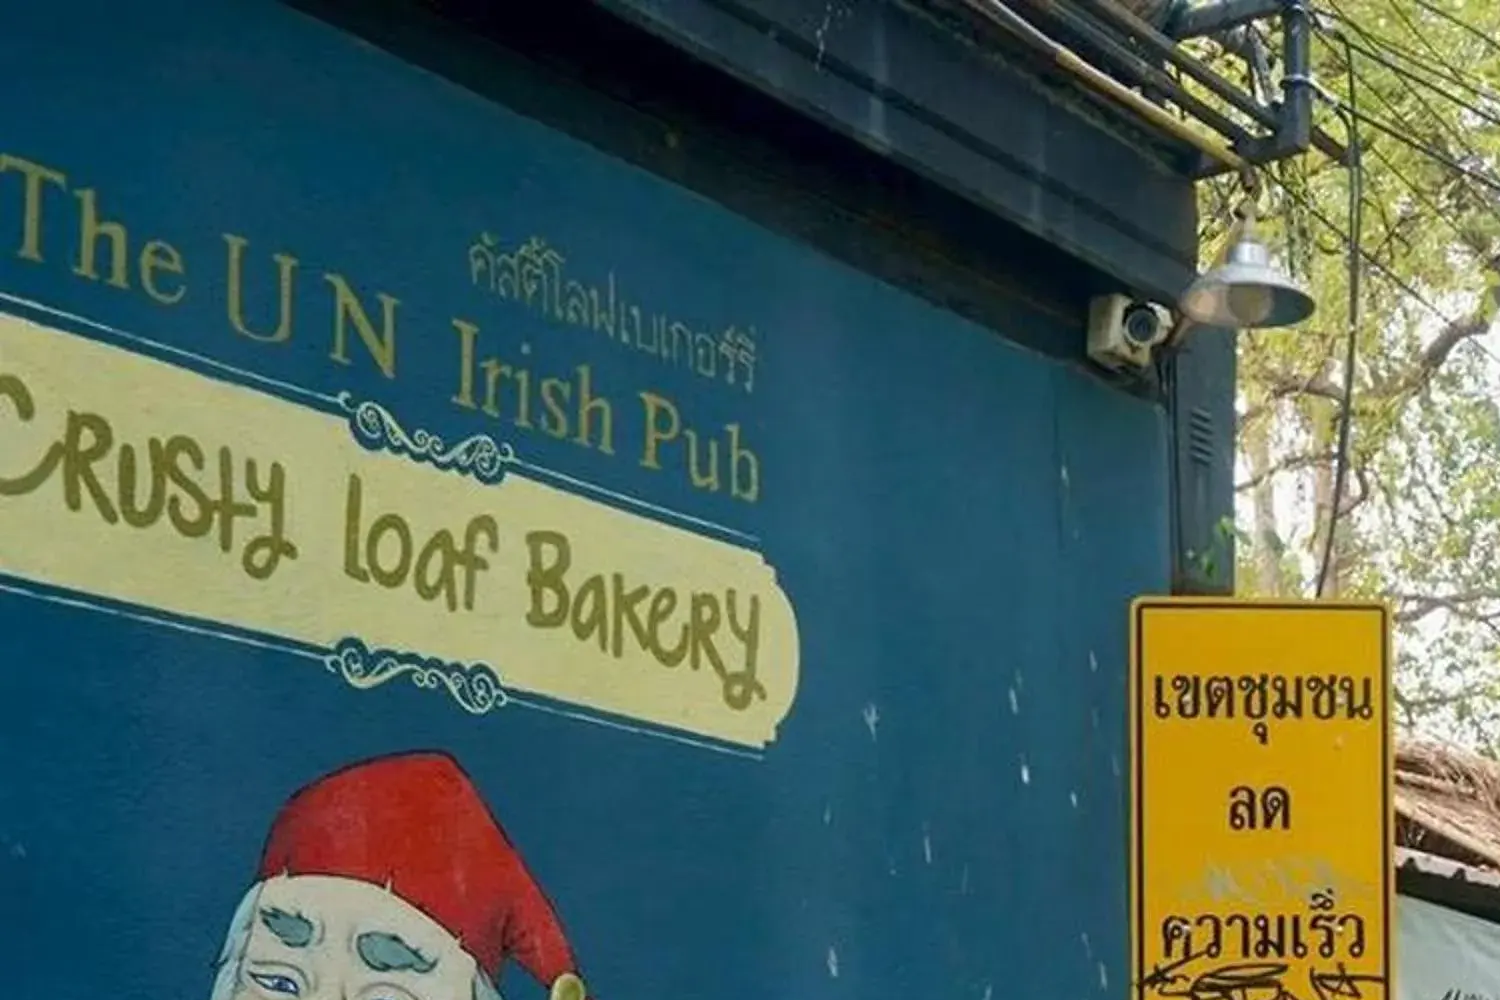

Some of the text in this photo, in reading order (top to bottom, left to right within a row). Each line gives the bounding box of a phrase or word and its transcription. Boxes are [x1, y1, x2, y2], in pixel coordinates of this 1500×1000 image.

[0, 155, 187, 305] The
[450, 318, 615, 454] Irish
[641, 392, 762, 503] Pub
[1153, 674, 1373, 745] เขตชุมชน
[1228, 785, 1291, 831] ลด
[1161, 888, 1366, 959] ความเร็ว
